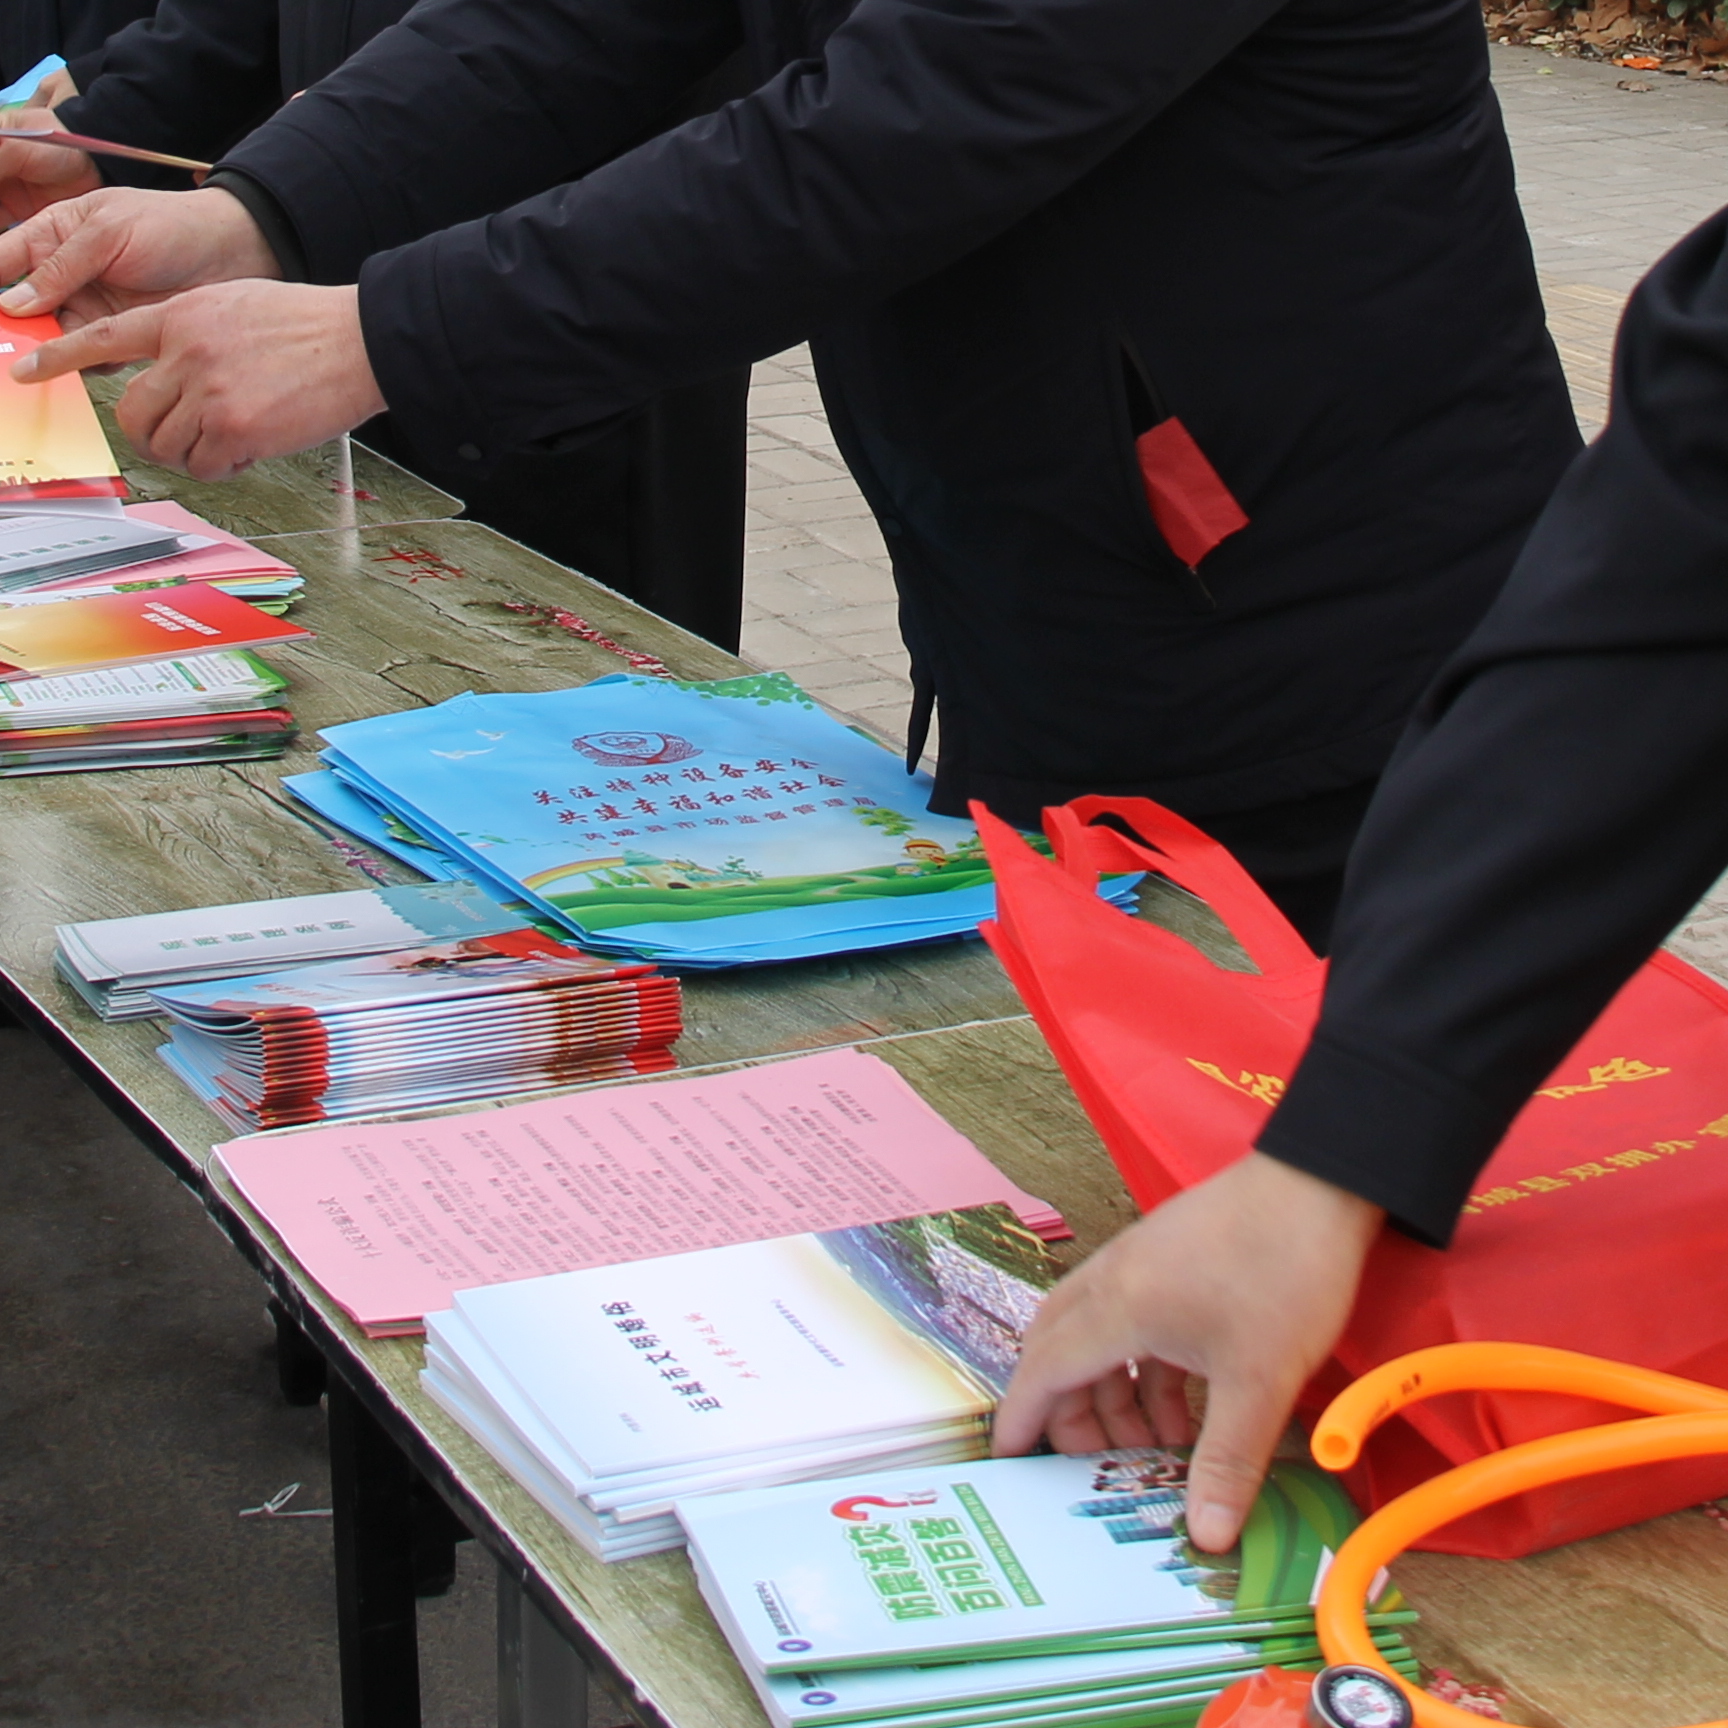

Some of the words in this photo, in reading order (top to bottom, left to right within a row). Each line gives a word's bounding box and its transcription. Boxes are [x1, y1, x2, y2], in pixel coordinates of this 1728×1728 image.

[532, 758, 820, 806] 关注特种设备安全
[595, 1298, 726, 1414] 运城市文明婚俗
[841, 1520, 945, 1621] 防震减灾
[902, 1513, 1008, 1613] 百问百答
